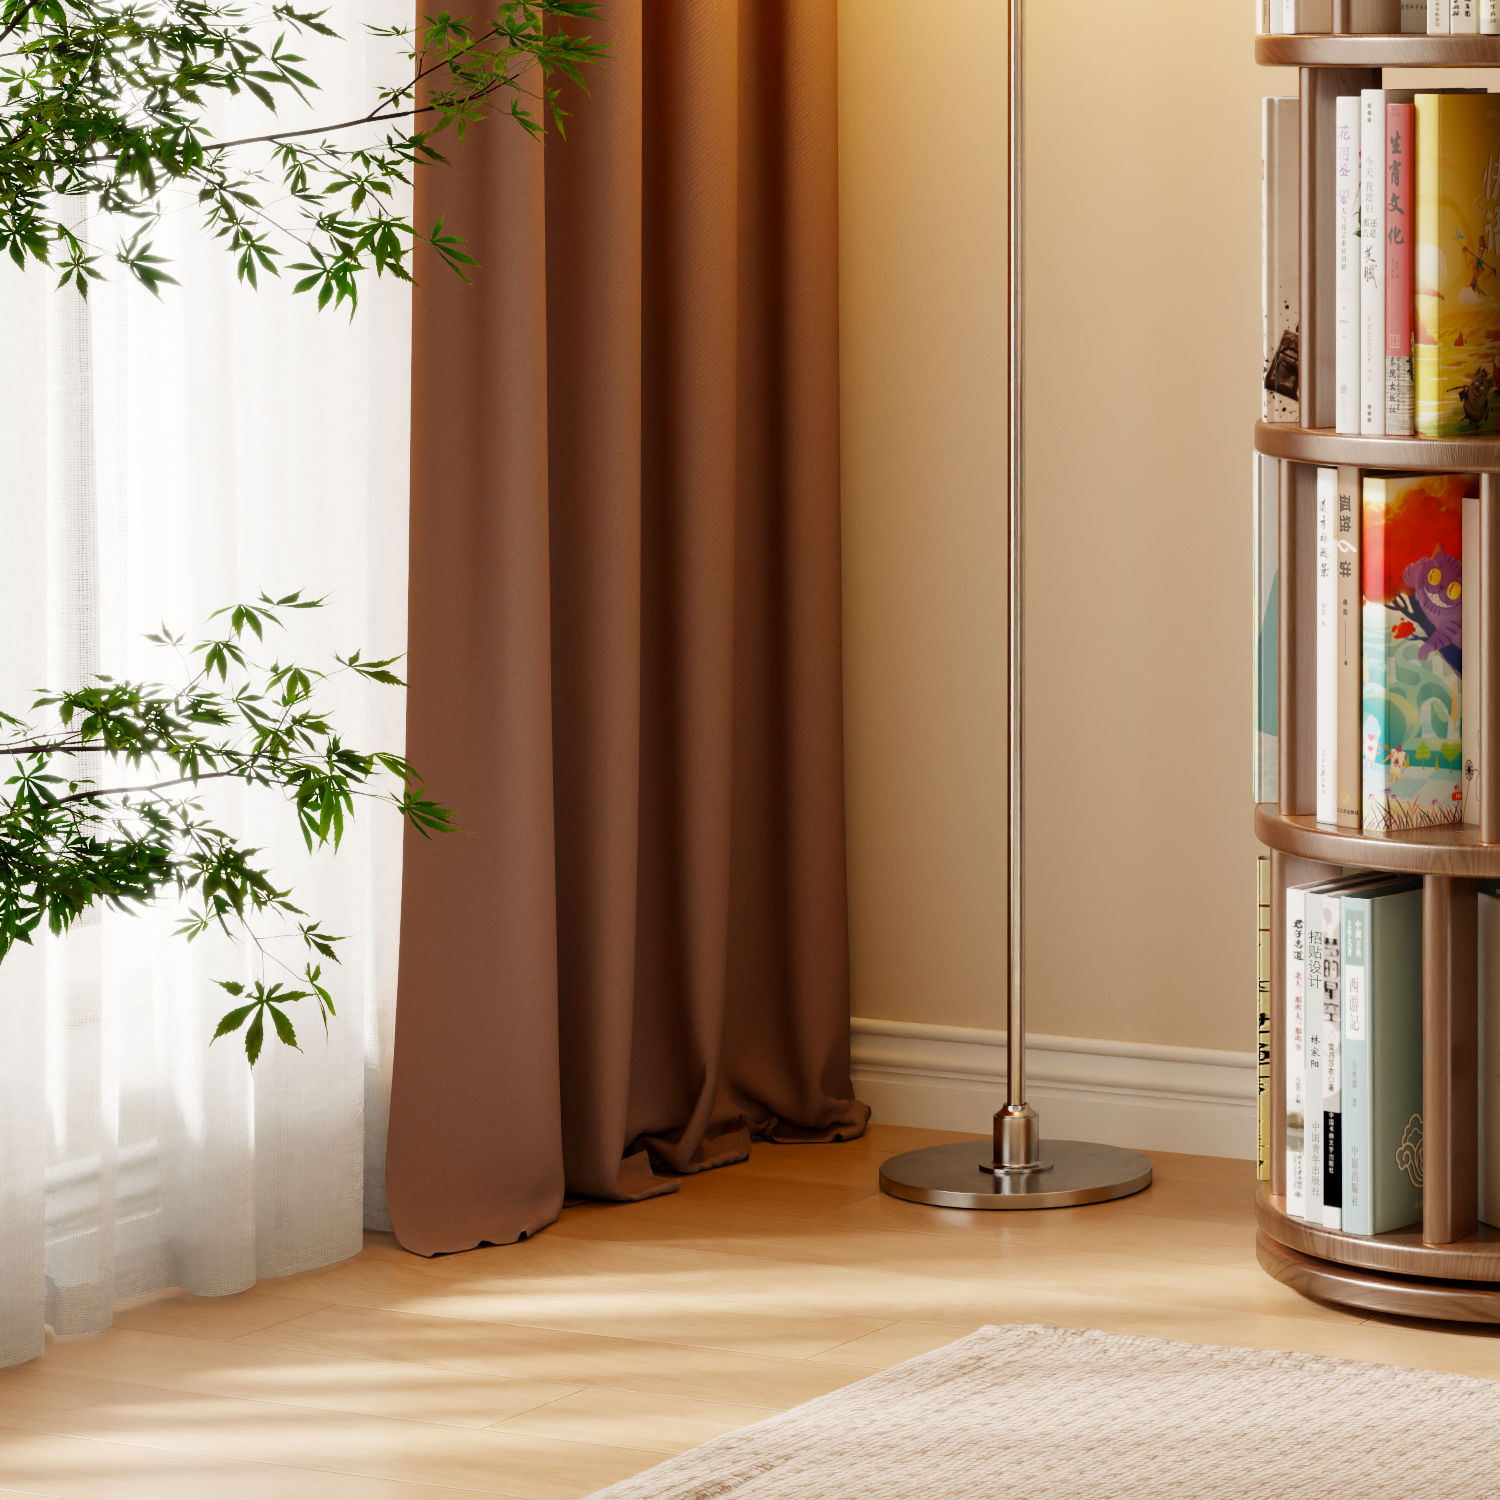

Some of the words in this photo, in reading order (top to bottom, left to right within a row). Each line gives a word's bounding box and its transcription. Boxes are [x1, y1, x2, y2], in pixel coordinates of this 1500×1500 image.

[1338, 124, 1351, 177] 花图鉴
[1387, 129, 1405, 245] 生肖文化
[1308, 929, 1323, 989] 招贴设计
[1311, 1121, 1321, 1197] 中国青年出版社
